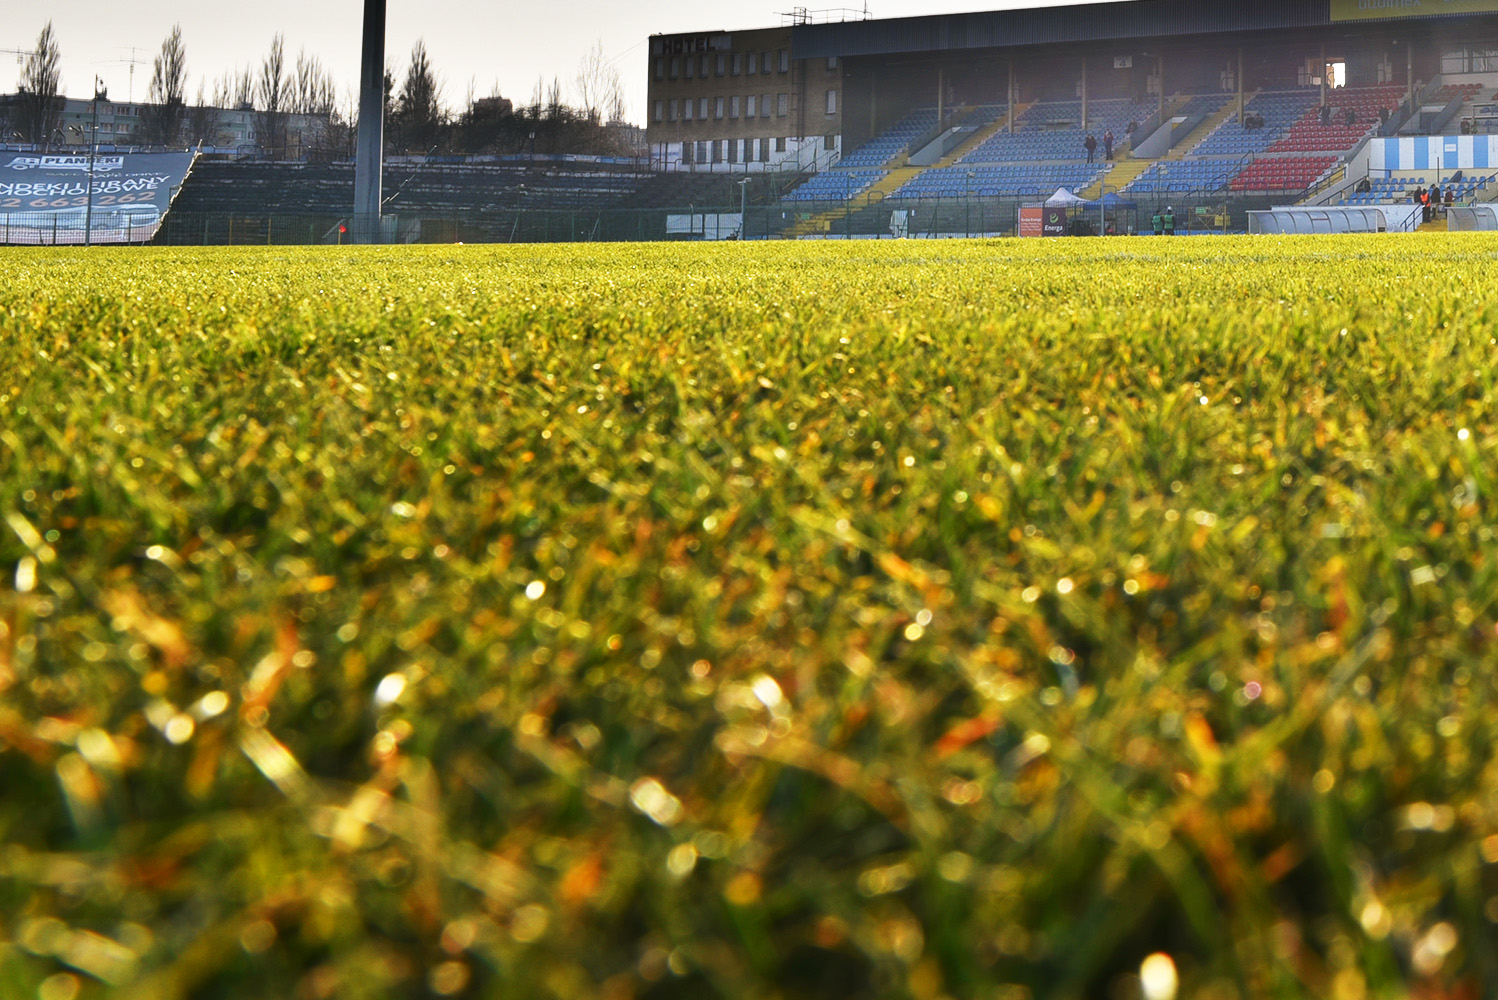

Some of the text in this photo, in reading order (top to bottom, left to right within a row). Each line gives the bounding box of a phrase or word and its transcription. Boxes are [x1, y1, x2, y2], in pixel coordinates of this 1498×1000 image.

[663, 37, 716, 54] HOTEL
[45, 157, 120, 165] PLANDEKI
[0, 191, 156, 208] 2 663 262
[1044, 224, 1063, 232] Energa
